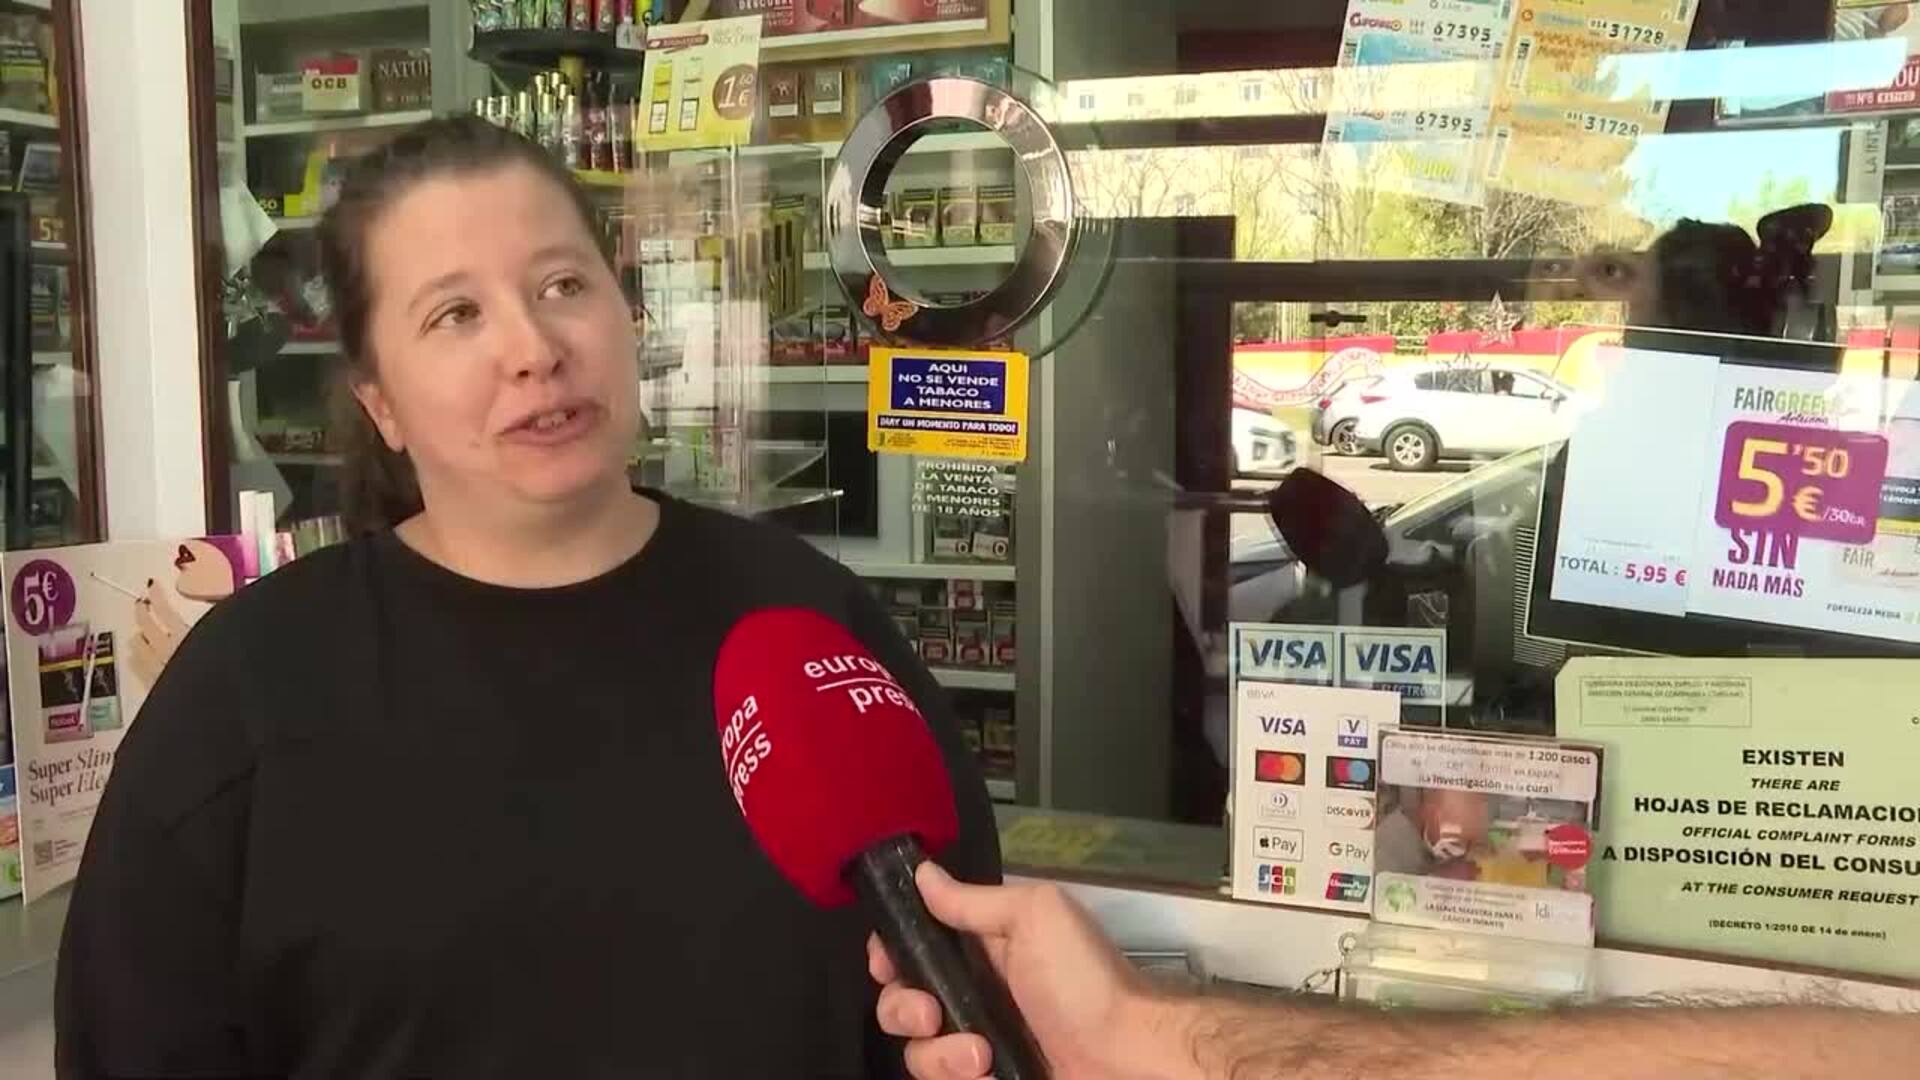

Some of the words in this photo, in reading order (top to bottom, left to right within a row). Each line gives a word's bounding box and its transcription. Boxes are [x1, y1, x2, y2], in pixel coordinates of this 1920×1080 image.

[1433, 21, 1491, 42] 67395
[1608, 23, 1664, 45] 31728
[311, 77, 348, 90] OCB
[1415, 111, 1473, 133] 67395
[1585, 115, 1640, 138] 31728
[928, 363, 968, 373] AQUI
[898, 374, 922, 383] NO
[925, 375, 943, 384] SE
[947, 376, 999, 387] VENDE
[916, 386, 979, 397] TABACO
[903, 397, 915, 406] A
[919, 398, 992, 409] MENORES
[902, 418, 915, 427] UN
[917, 420, 961, 430] MOMENTO
[962, 422, 986, 431] PARA
[916, 461, 998, 473] PROHIBIDA
[921, 472, 938, 481] LA
[943, 473, 993, 484] VENTA
[914, 482, 933, 492] DE
[939, 483, 1000, 496] TABACO
[912, 492, 923, 501] A
[926, 494, 1001, 507] MENORES
[911, 503, 930, 514] DE
[938, 505, 954, 515] 18
[958, 505, 1001, 518] AÑOS
[1728, 528, 1799, 569] SIN
[1560, 556, 1609, 575] TOTAL
[1624, 563, 1667, 583] 5,95
[1675, 569, 1687, 587] €
[1713, 568, 1758, 592] NADA
[1763, 574, 1804, 598] MÁS
[1826, 603, 1873, 616] FORTALEZA
[1248, 639, 1327, 669] VISA
[1355, 642, 1436, 674] VISA
[1259, 716, 1307, 736] VISA
[1347, 719, 1360, 734] V
[1344, 737, 1361, 745] PAY
[1560, 754, 1591, 765] casos
[1742, 749, 1845, 767] EXISTEN
[29, 757, 73, 783] Super
[30, 781, 74, 806] Super
[1750, 777, 1802, 790] THERE
[1807, 779, 1841, 792] ARE
[1327, 806, 1371, 818] DISCOVER
[1634, 797, 1710, 815] HOJAS
[1717, 800, 1748, 816] DE
[1755, 802, 1920, 823] RECLAMACIO
[1272, 836, 1297, 854] Pay
[1682, 826, 1752, 840] OFFICIAL
[1757, 829, 1852, 845] COMPLAINT
[1856, 833, 1917, 848] FORMS
[1346, 843, 1371, 861] Pay
[1602, 846, 1617, 860] A
[1624, 846, 1772, 868] DISPOSICIÓN
[1780, 853, 1826, 871] DEL
[1682, 882, 1704, 893] AT
[1707, 883, 1738, 895] THE
[1742, 885, 1833, 901] CONSUMER
[1837, 890, 1919, 906] REQUEST
[1709, 919, 1762, 931] (DECRETO
[1801, 925, 1816, 934] DE
[1819, 926, 1832, 936] 14
[1834, 928, 1848, 937] de
[1850, 930, 1886, 940] enero)
